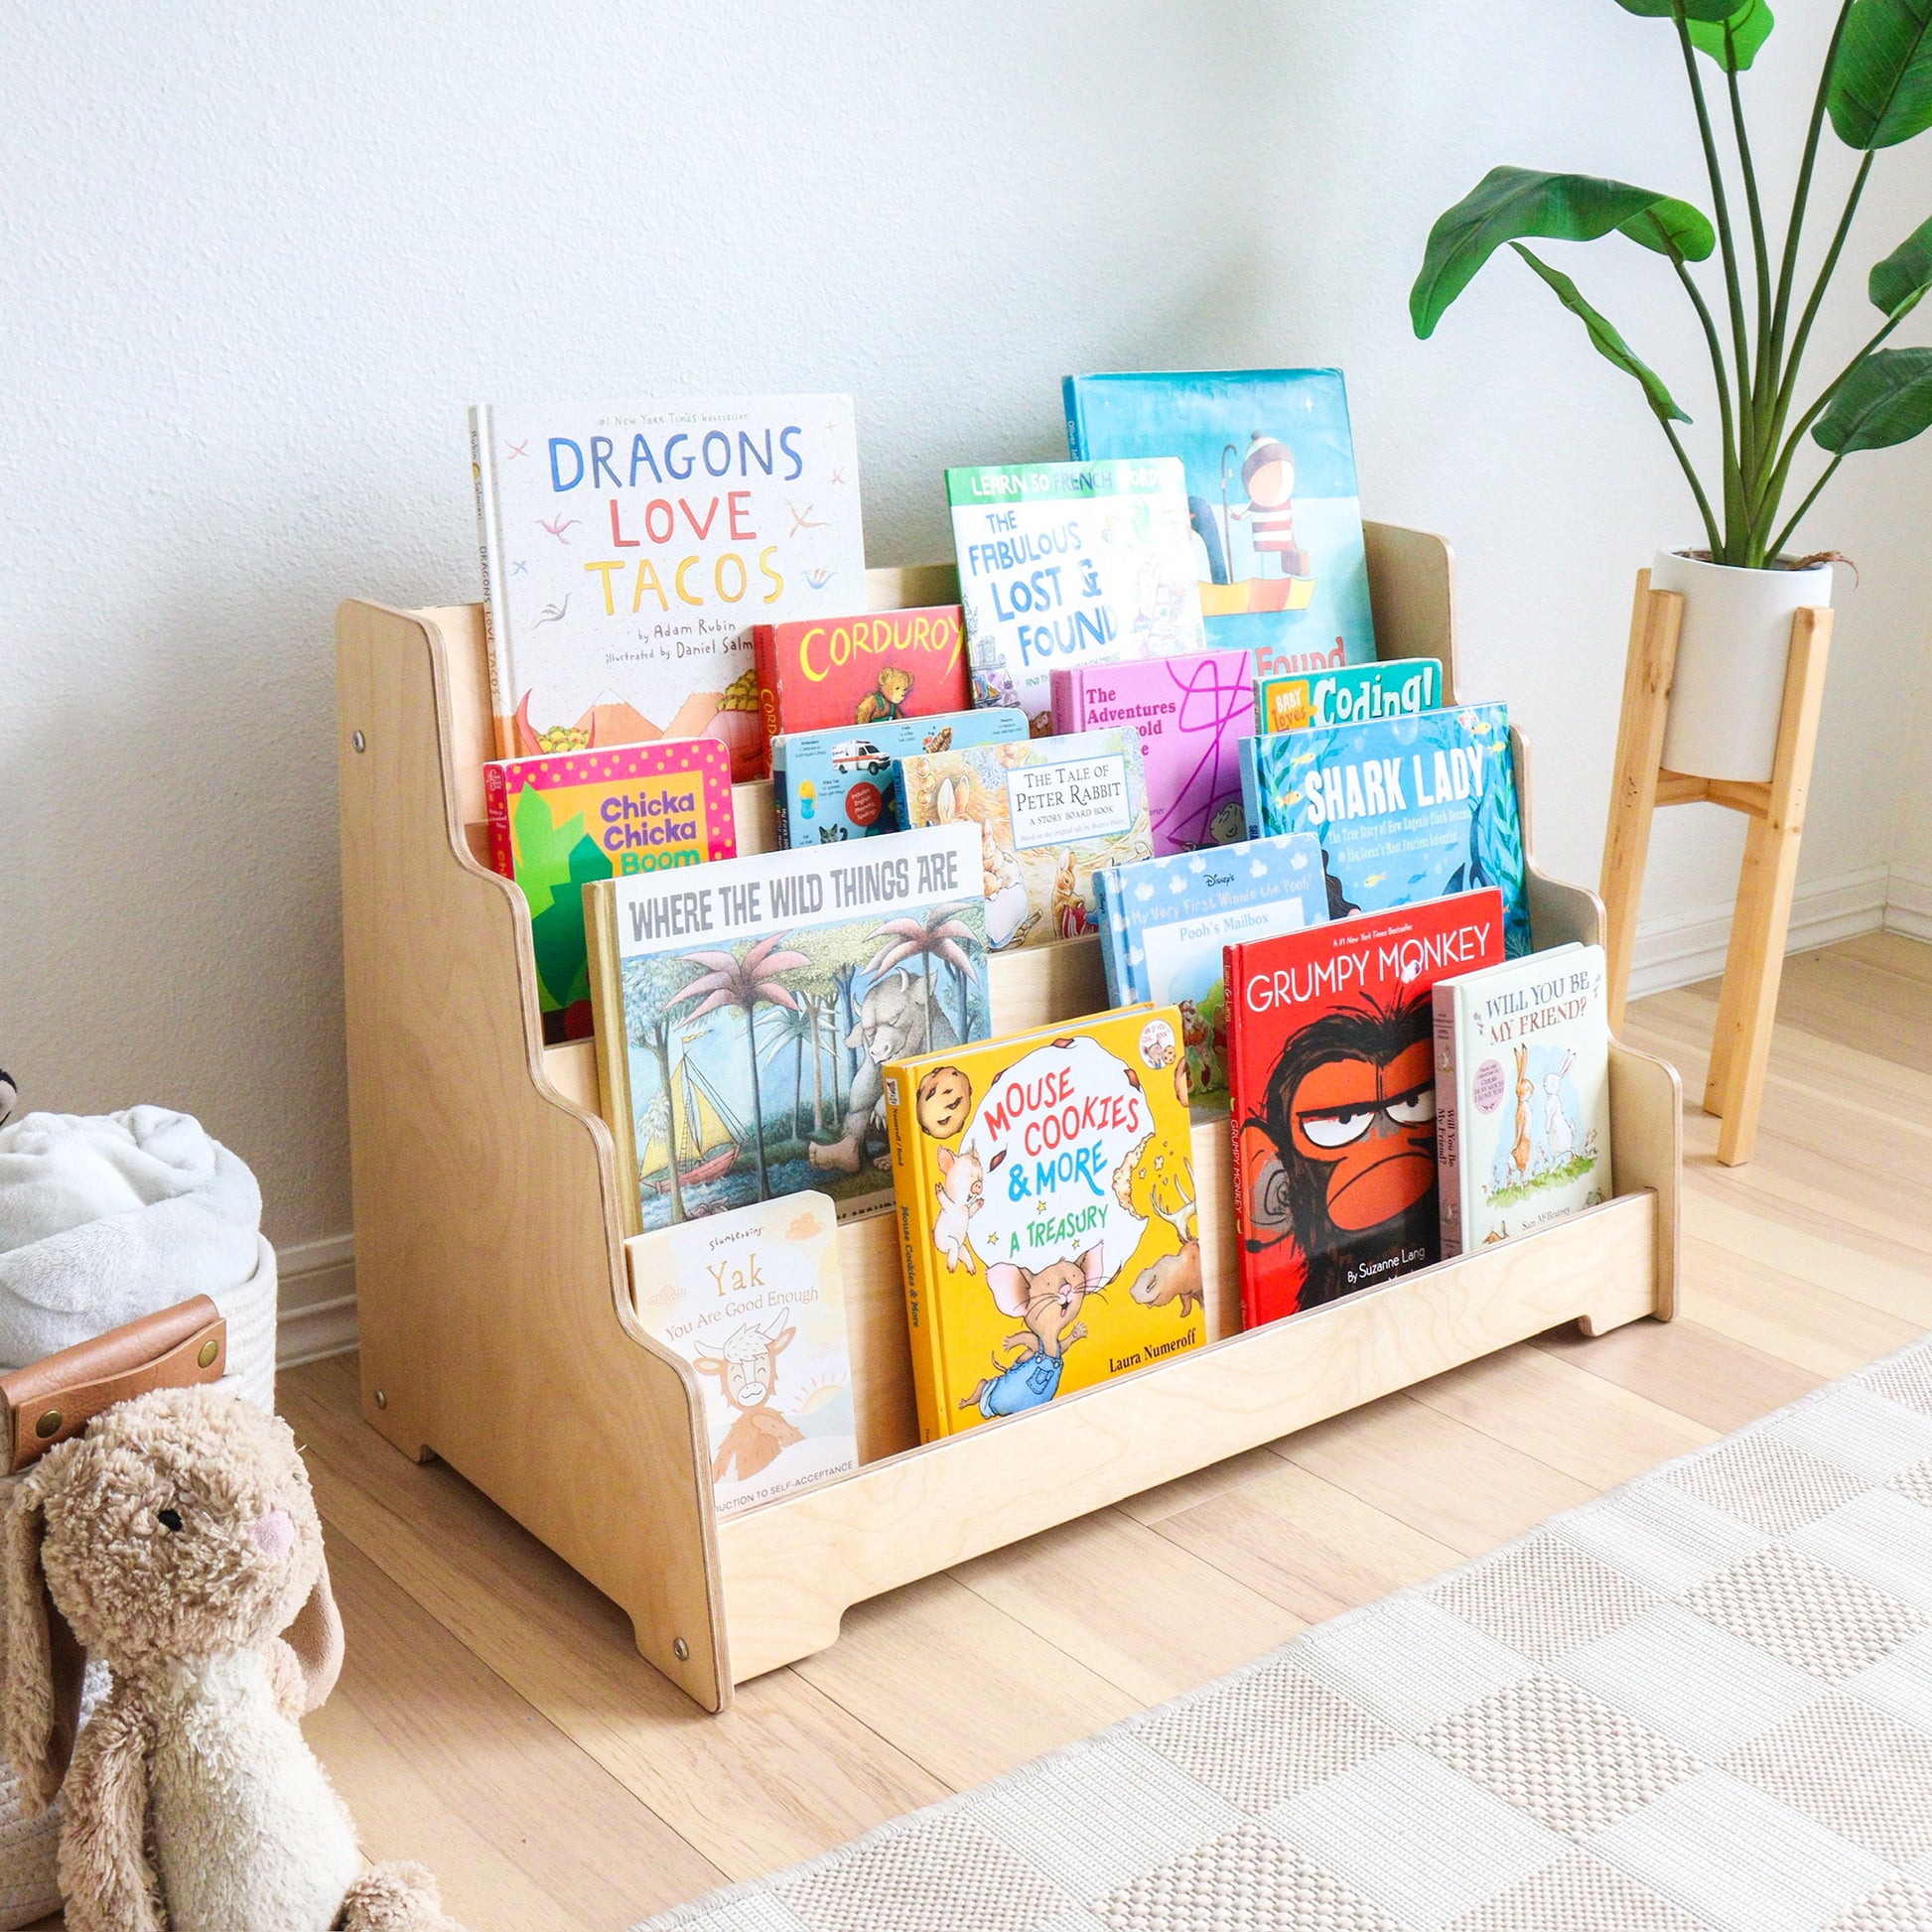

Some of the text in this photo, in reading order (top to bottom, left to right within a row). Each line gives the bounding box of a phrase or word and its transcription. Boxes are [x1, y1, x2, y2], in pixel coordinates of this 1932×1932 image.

[548, 426, 803, 492] DRAGONS
[971, 474, 1027, 496] LEARN
[1031, 473, 1049, 493] 50
[1053, 471, 1113, 491] FRENCH
[609, 490, 758, 548] LOVE
[986, 510, 1018, 534] THE
[968, 521, 1082, 577] FABULOUS
[479, 545, 491, 604] DRAGONS
[584, 545, 784, 616] TACOS
[991, 558, 1102, 622] LOST &
[484, 611, 495, 641] LOVE
[638, 619, 737, 643] by Adam Rubin
[1018, 604, 1120, 667] FOUND
[606, 649, 654, 663] illustrated
[660, 648, 670, 660] by
[676, 639, 716, 658] Daniel
[799, 615, 964, 685] CORDUROY
[1255, 636, 1345, 677] Found
[1086, 687, 1116, 705] The
[1087, 700, 1176, 725] Adventures
[1275, 688, 1302, 713] BABY
[1312, 666, 1434, 727] Coding!
[1016, 781, 1122, 812] PETER RABBIT
[1024, 764, 1110, 788] THE TALE OF
[1305, 745, 1485, 826] SHARK LADY
[600, 790, 696, 823] Chicka
[1037, 813, 1062, 825] STORY
[1065, 808, 1092, 821] BOARD
[1093, 805, 1114, 815] BOOK
[603, 819, 697, 852] Chicka
[621, 848, 701, 876] Boom
[1202, 873, 1235, 888] Disney's
[628, 850, 959, 943] WHERE THE WILD THINGS ARE
[1132, 878, 1310, 925] My Very First Winnie the Pooh
[1179, 912, 1270, 941] Pooh's Mailbox
[1346, 936, 1359, 945] New
[1360, 932, 1372, 941] York
[1372, 930, 1387, 939] Times
[1388, 923, 1413, 935] Bestseller
[1247, 922, 1491, 1013] GRUMPY MONKEY
[1485, 971, 1589, 1020] WILL YOU BE
[1490, 996, 1588, 1045] MY FRIEND?
[984, 1066, 1075, 1142] MOUSE
[1024, 1093, 1141, 1157] COOKIES
[1009, 1139, 1108, 1202] & MORE
[1230, 1119, 1243, 1214] GRUMPY MONKEY
[709, 1226, 763, 1251] slumberkins
[1009, 1203, 1109, 1258] A TREASURY
[706, 1253, 765, 1298] Yak
[905, 1244, 915, 1287] Cookies
[1347, 1271, 1358, 1284] By
[1359, 1256, 1400, 1279] Suzanne
[1401, 1247, 1426, 1264] Lang
[665, 1287, 819, 1342] You Are Good Enough
[909, 1289, 918, 1298] &
[1109, 1327, 1196, 1373] Laura Numeroff
[757, 1489, 768, 1500] TO
[770, 1460, 854, 1496] SELF-ACCEPTANCE
